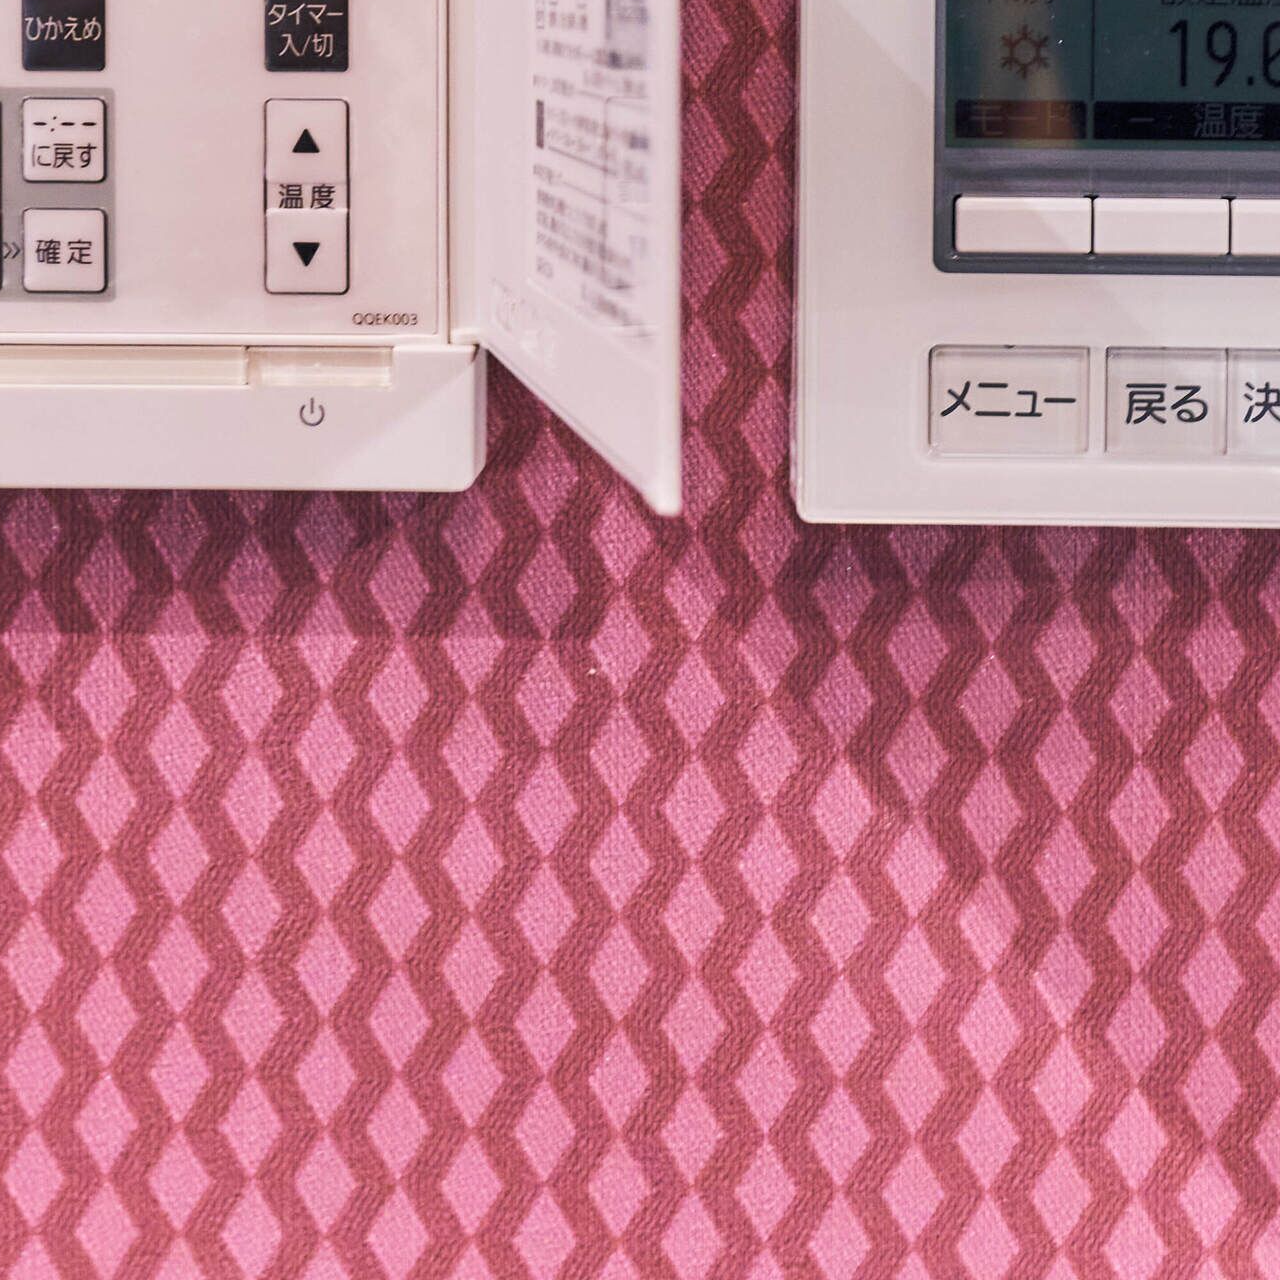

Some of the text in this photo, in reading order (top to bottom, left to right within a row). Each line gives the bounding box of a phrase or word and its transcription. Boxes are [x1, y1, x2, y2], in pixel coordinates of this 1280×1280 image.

[268, 2, 345, 26] タイマー
[24, 15, 103, 42] ひかえめ
[278, 33, 335, 59] 入/切
[1193, 102, 1265, 139] 温度
[31, 142, 98, 170] に戻す
[278, 183, 337, 210] 温度
[34, 239, 94, 266] 確定
[939, 379, 1078, 420] メニュー
[1124, 381, 1210, 426] 戻る
